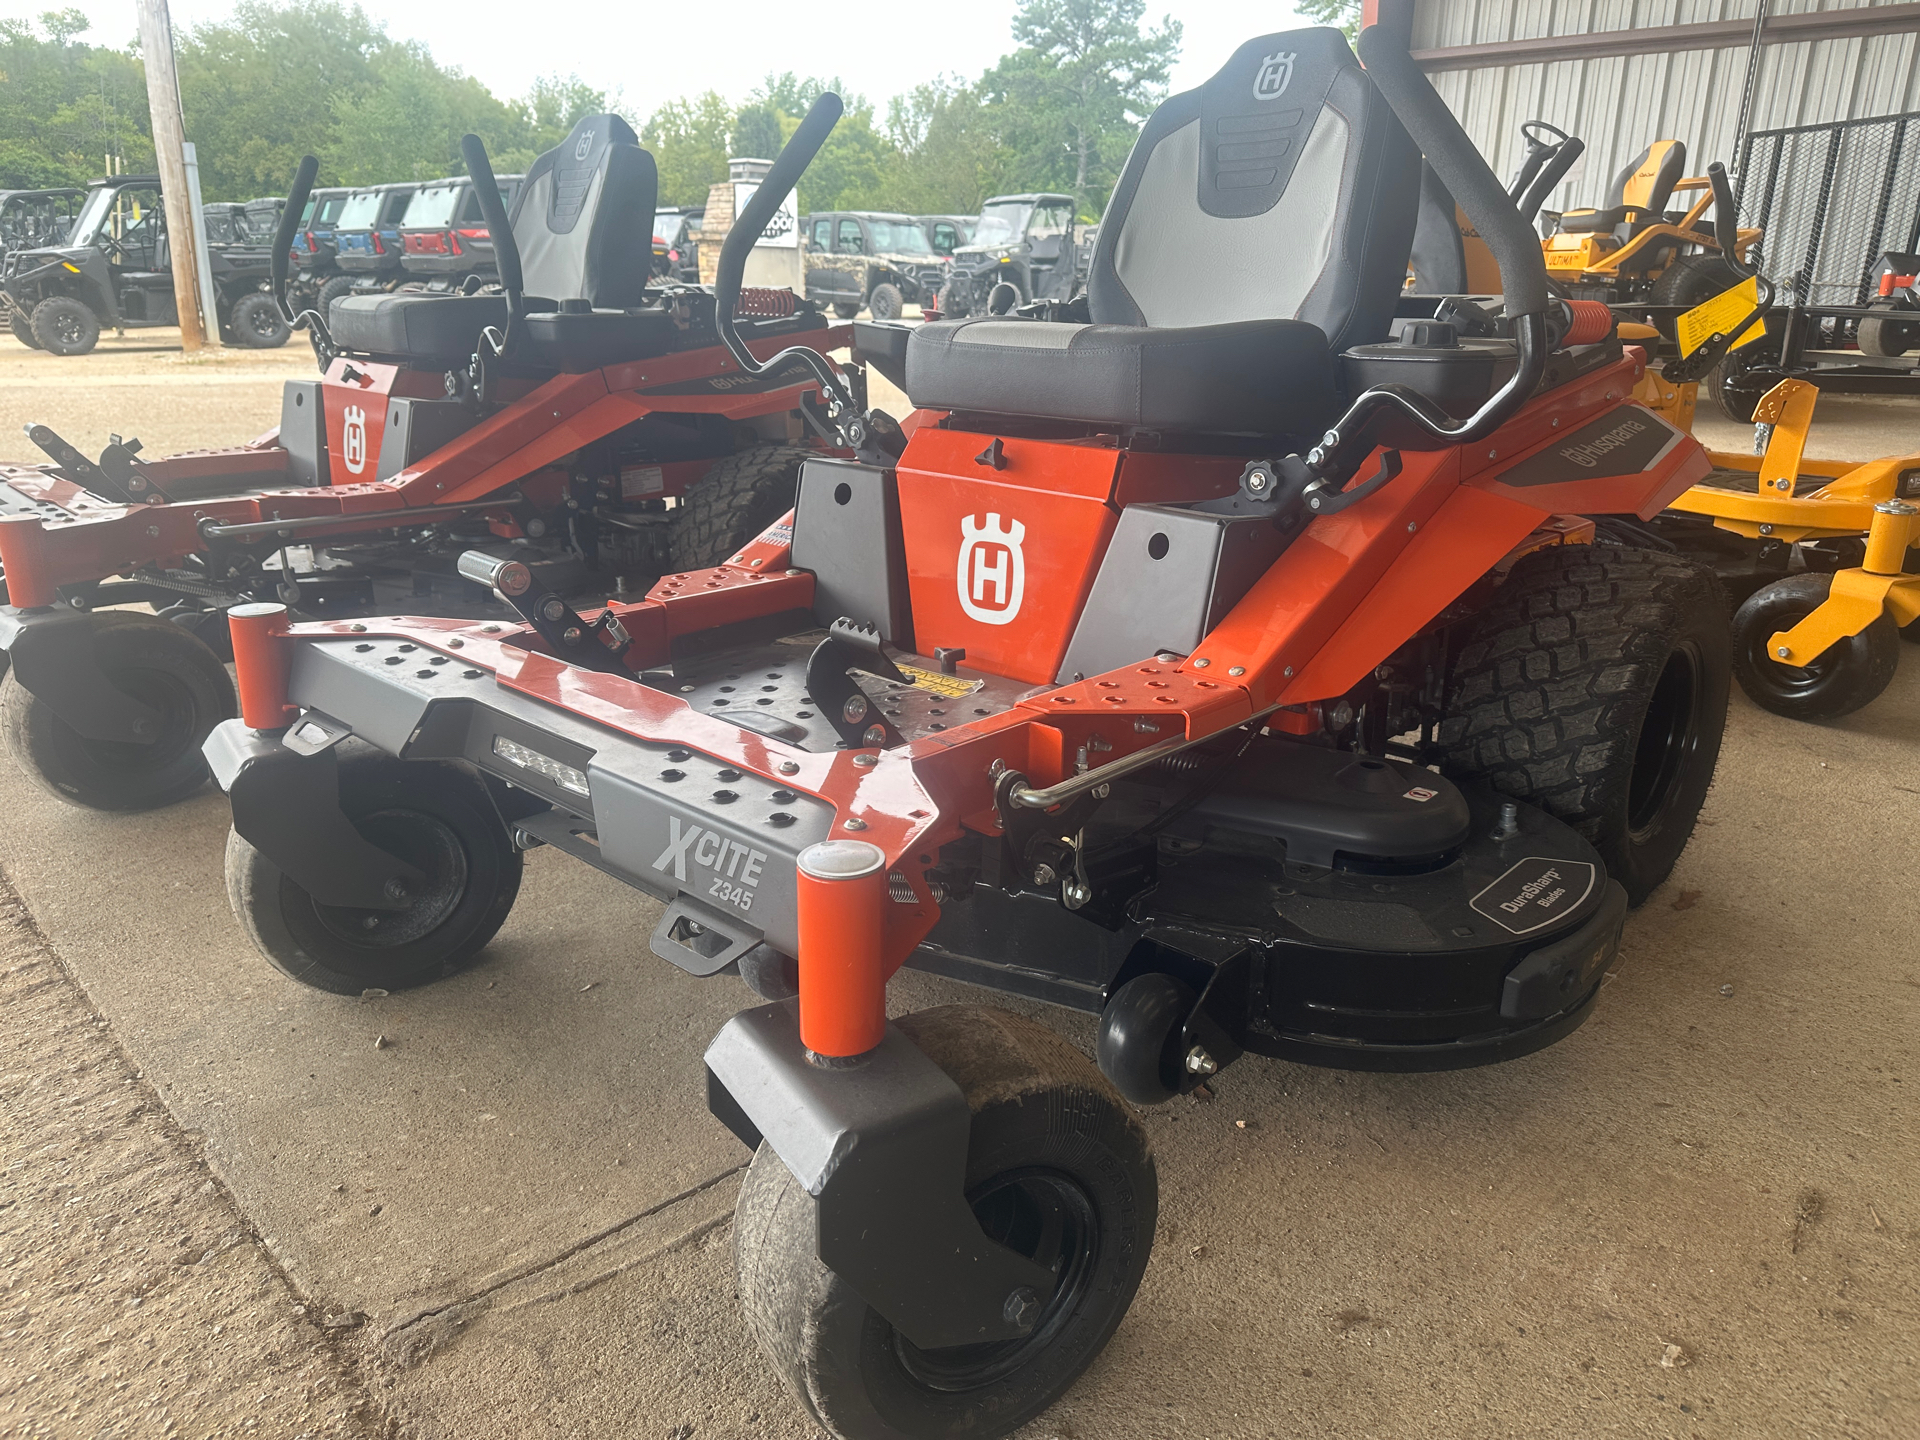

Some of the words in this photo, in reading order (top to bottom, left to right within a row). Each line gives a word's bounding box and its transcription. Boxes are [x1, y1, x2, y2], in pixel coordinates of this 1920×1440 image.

[1575, 420, 1647, 459] Husqvarna
[651, 815, 769, 889] XCITE
[708, 877, 755, 912] Z345
[1536, 887, 1567, 908] Blades
